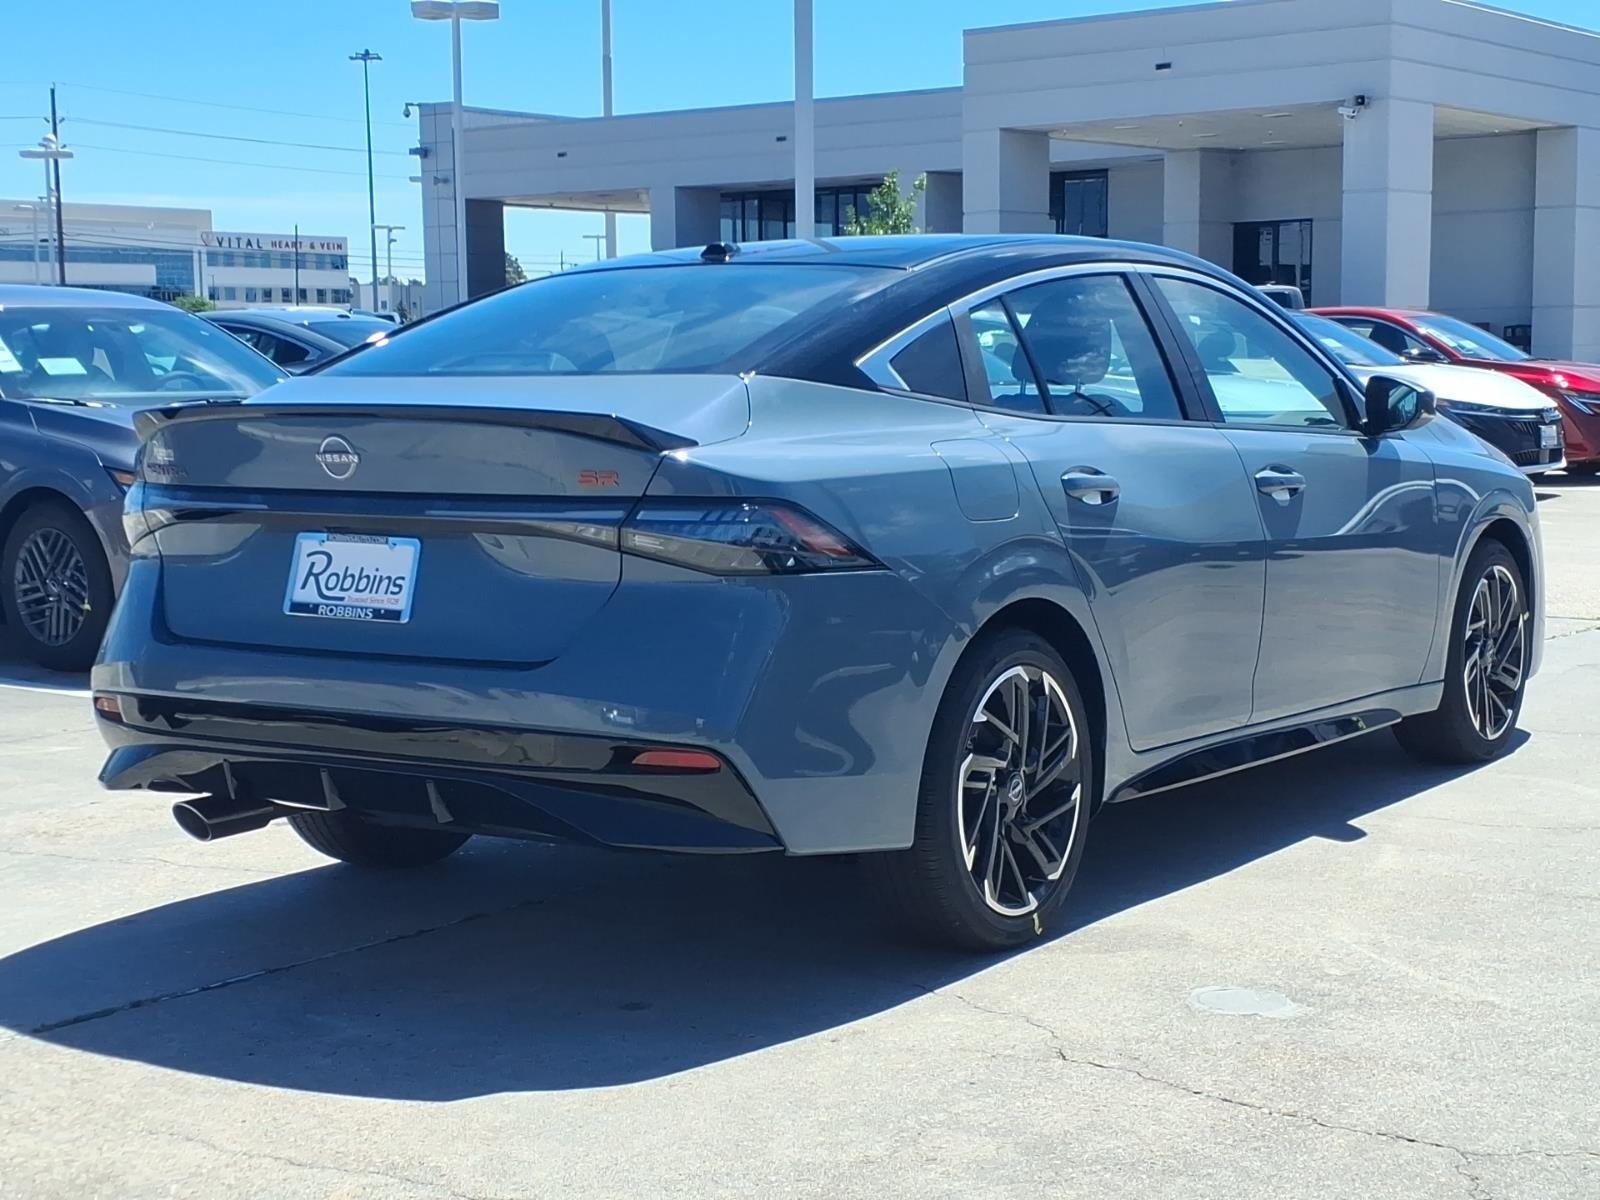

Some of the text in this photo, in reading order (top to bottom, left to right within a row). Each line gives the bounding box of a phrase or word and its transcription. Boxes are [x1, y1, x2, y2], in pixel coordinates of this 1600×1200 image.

[216, 236, 343, 251] VITAL HEART & VEIN
[315, 452, 360, 464] NISSAN
[577, 469, 620, 487] SR
[300, 550, 406, 602] Robbins
[318, 604, 374, 619] ROBBINS
